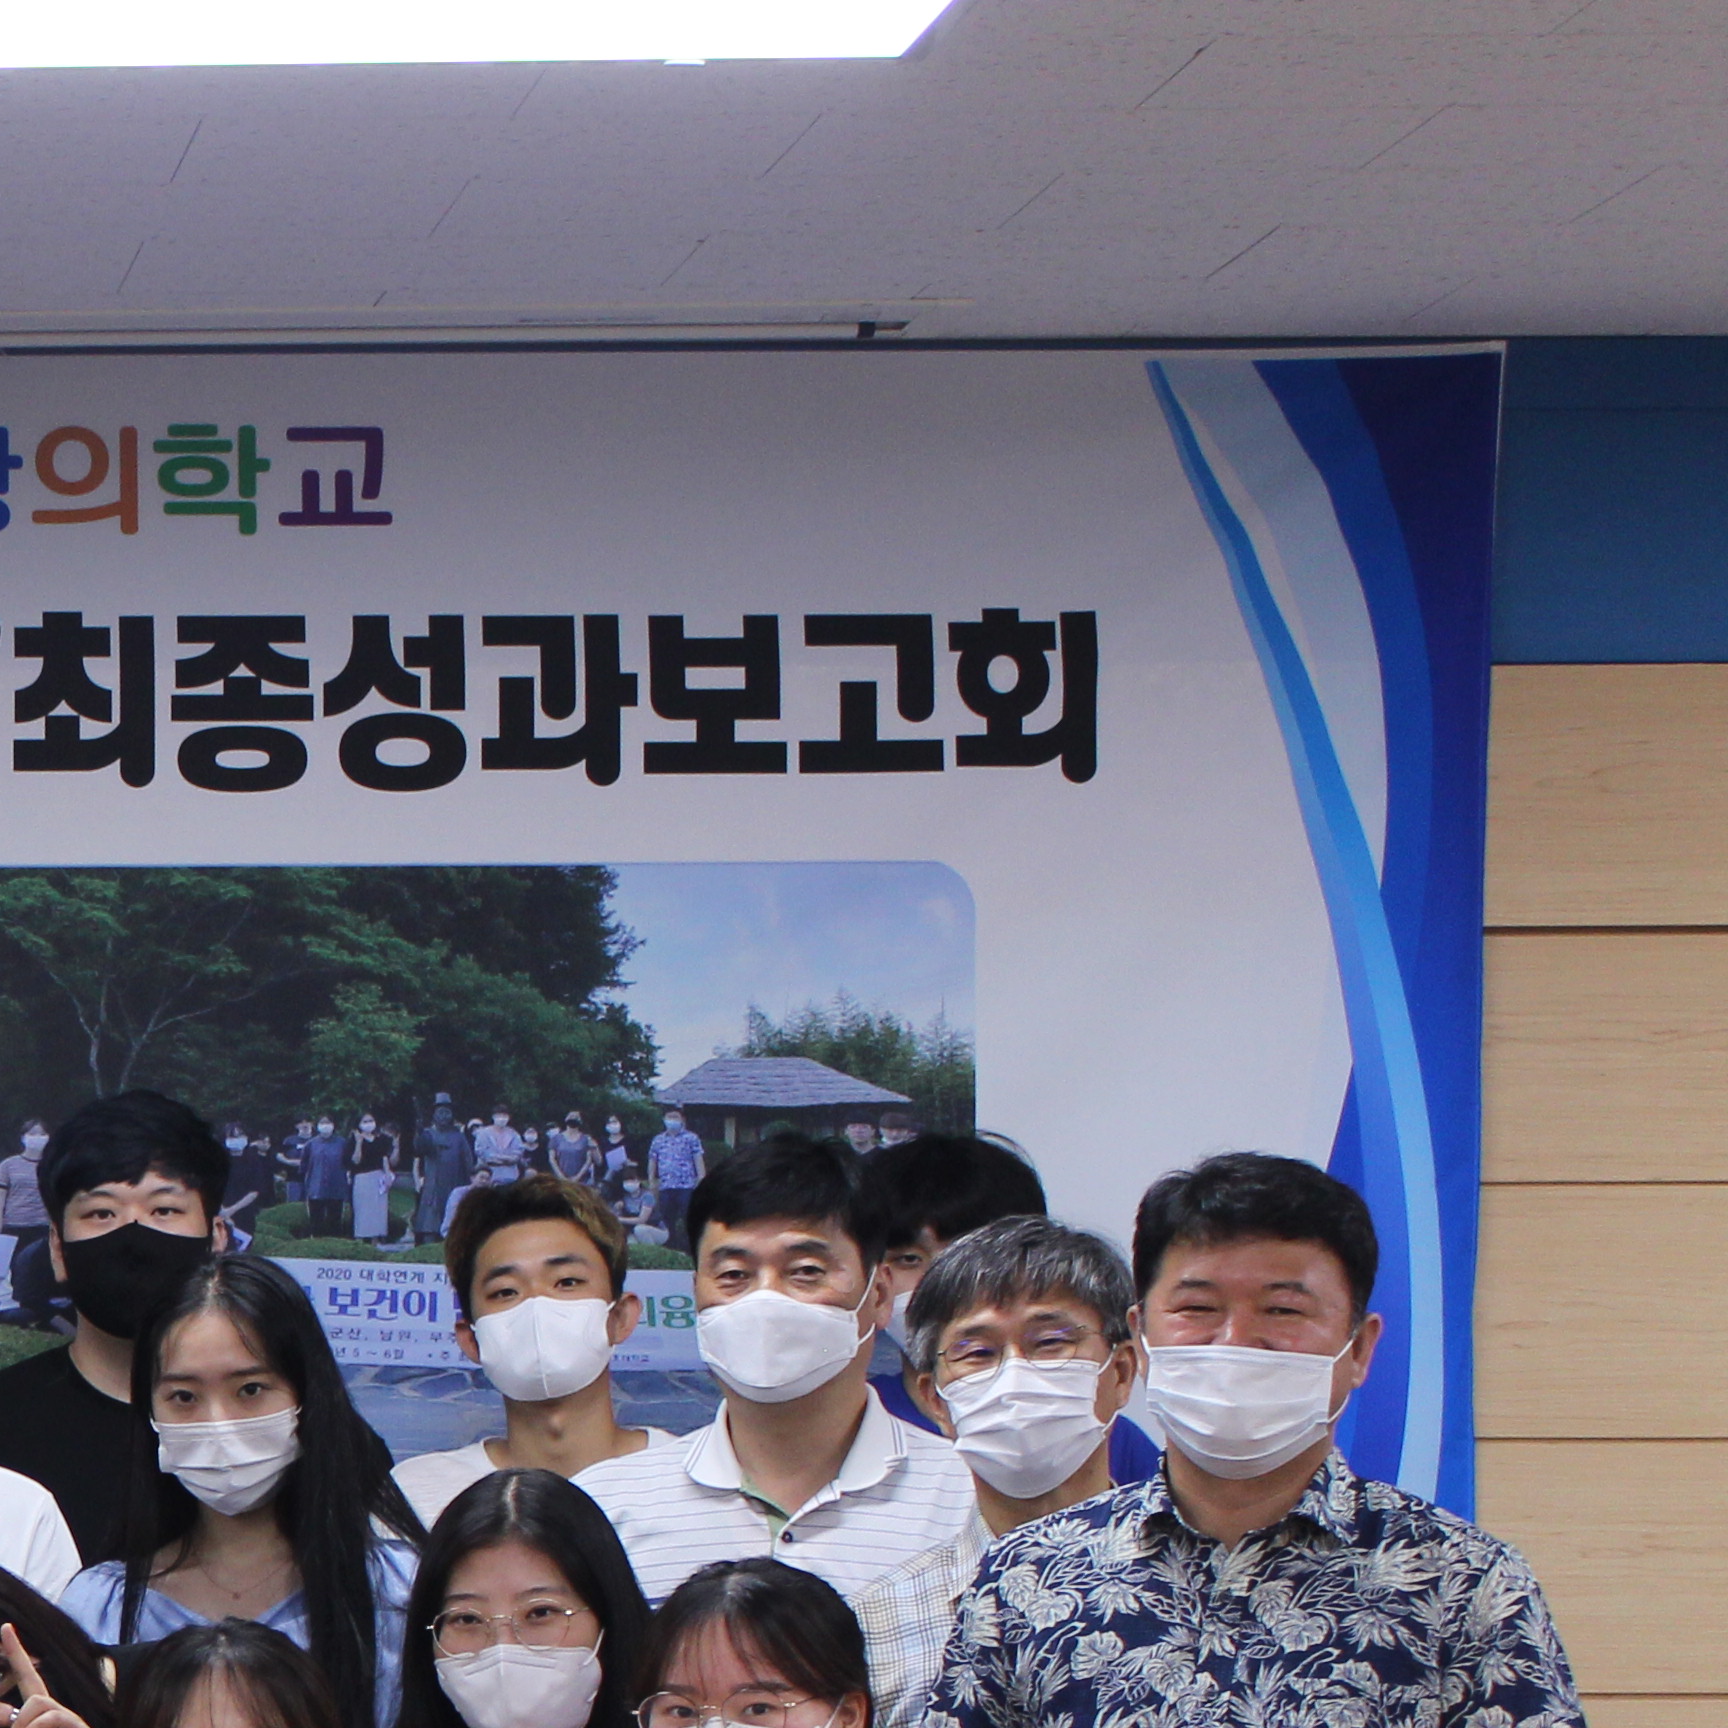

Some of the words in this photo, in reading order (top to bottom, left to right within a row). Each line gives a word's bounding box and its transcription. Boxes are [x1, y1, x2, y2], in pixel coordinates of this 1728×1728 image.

[317, 1267, 352, 1281] 2020
[359, 1269, 425, 1284] 대학연계
[324, 1287, 438, 1323] 보건이
